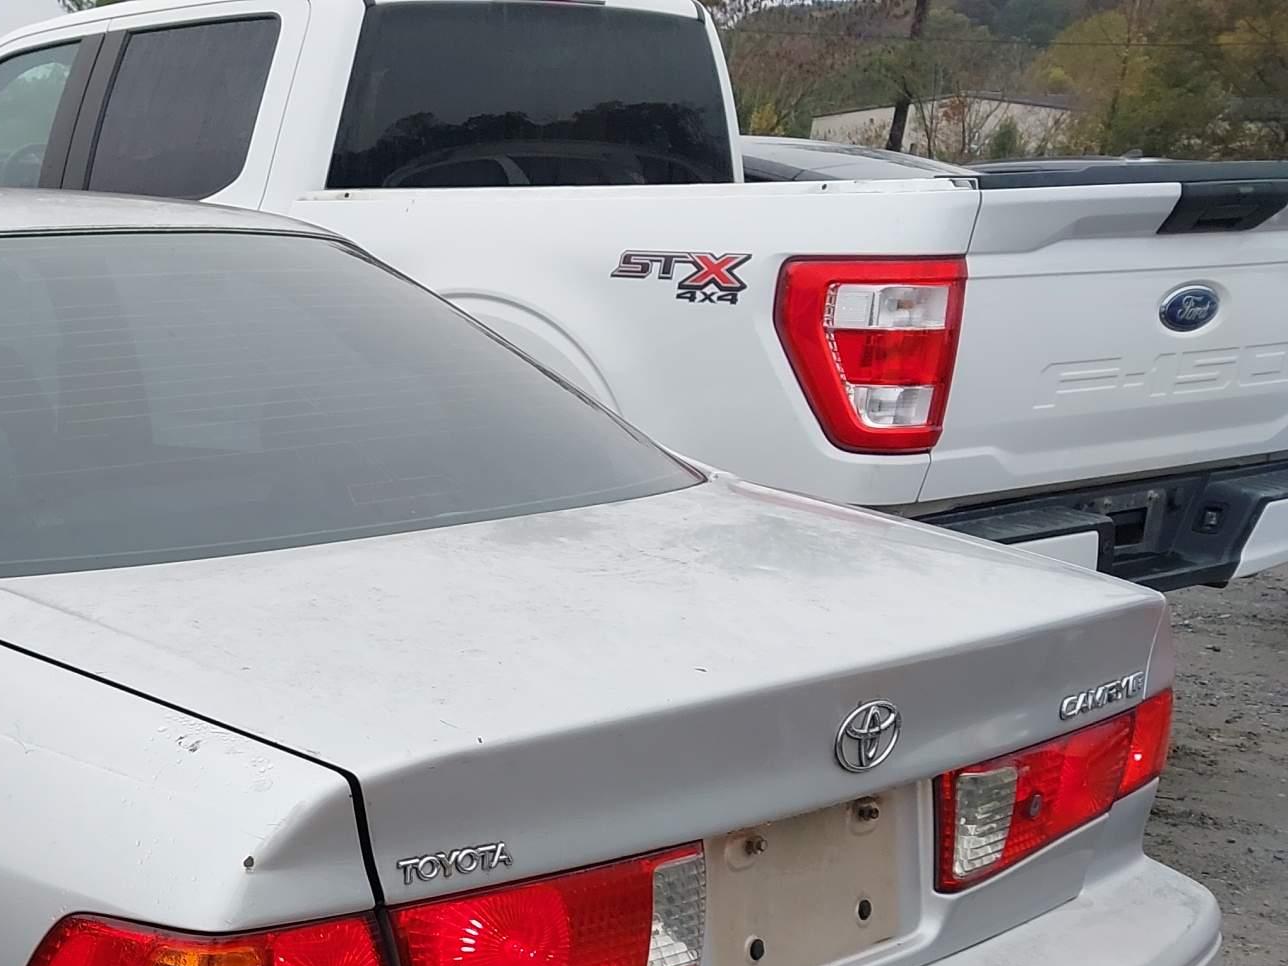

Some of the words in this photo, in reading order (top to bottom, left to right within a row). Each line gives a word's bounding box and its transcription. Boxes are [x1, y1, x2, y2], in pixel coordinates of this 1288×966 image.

[610, 249, 753, 292] STX
[1176, 295, 1212, 321] Ford
[1058, 676, 1129, 720] CAMRY
[396, 840, 513, 885] TOYOTA
